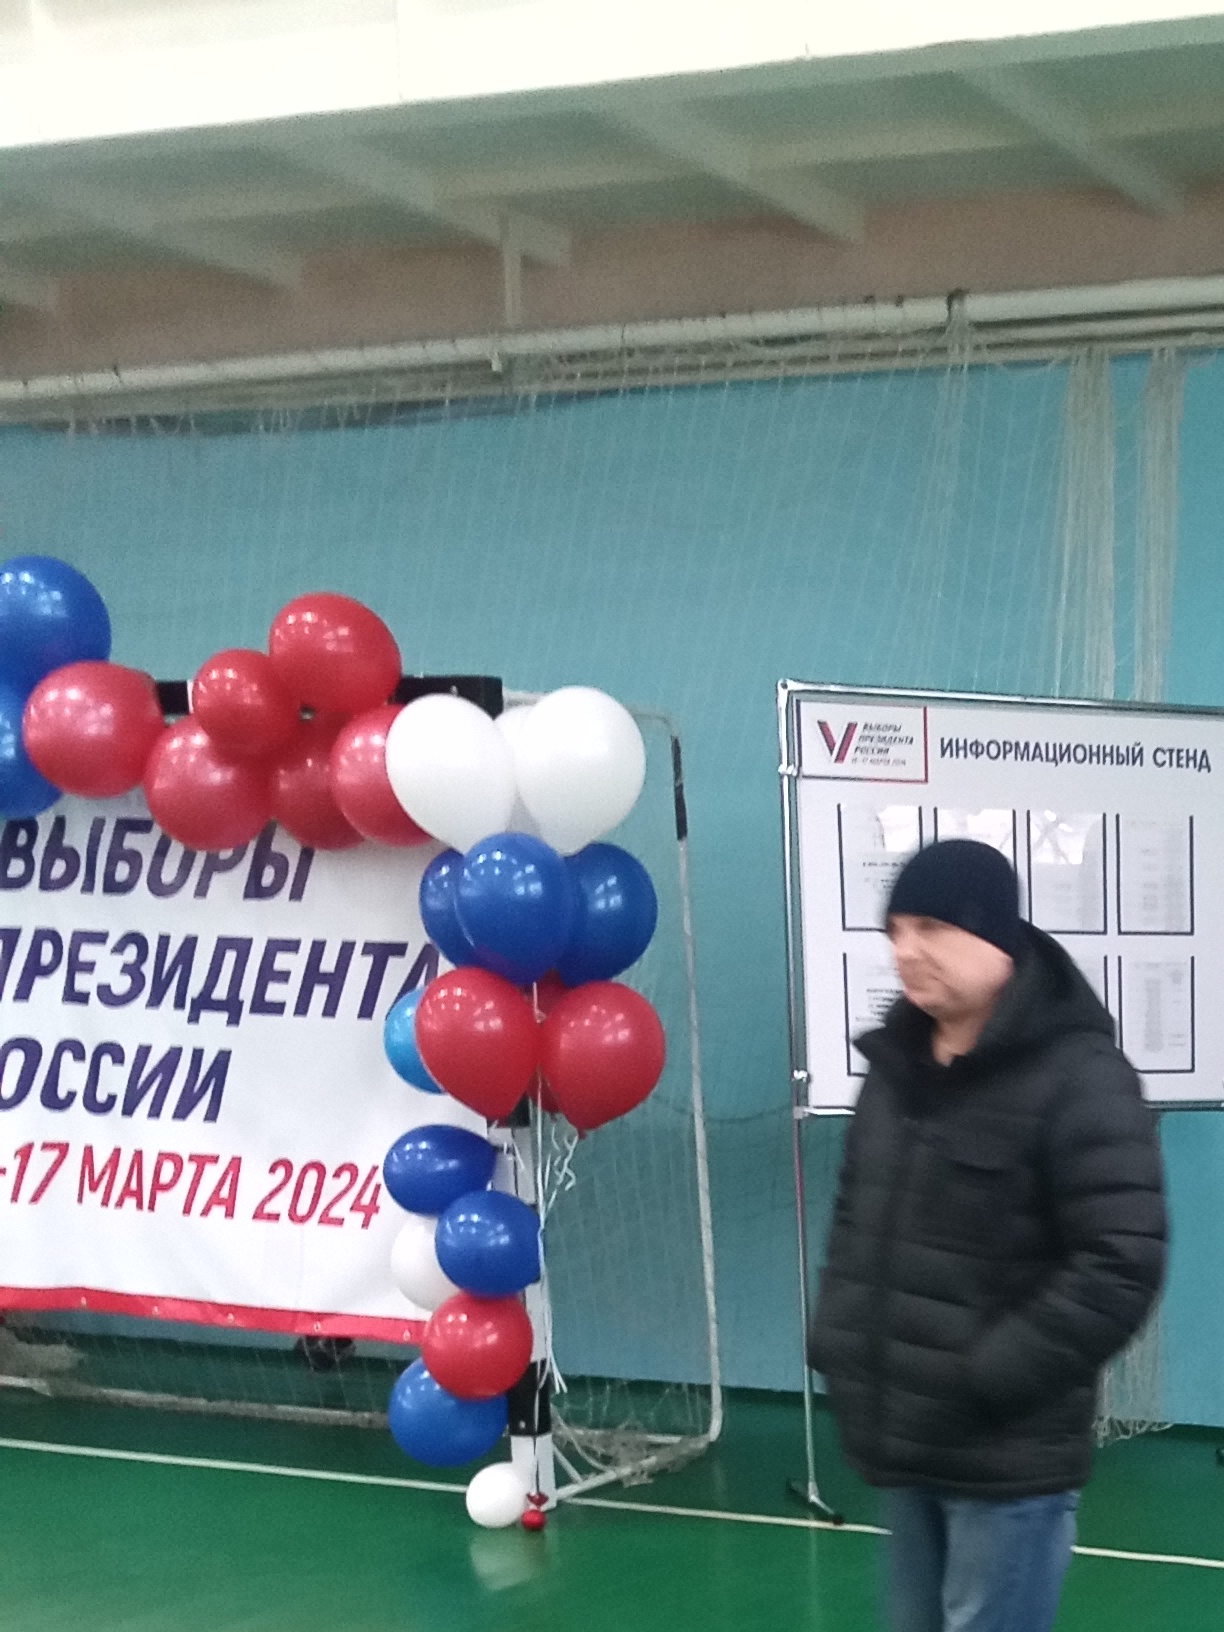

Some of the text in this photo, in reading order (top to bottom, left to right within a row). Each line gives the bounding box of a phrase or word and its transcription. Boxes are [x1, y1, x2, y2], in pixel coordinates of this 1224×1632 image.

[939, 736, 1213, 774] ИНФОРМАЦИОННЫЙ СТЕНД
[0, 815, 316, 902] ВЫБОРЫ
[76, 1143, 243, 1220] МАРТА
[251, 1157, 383, 1230] 2024
